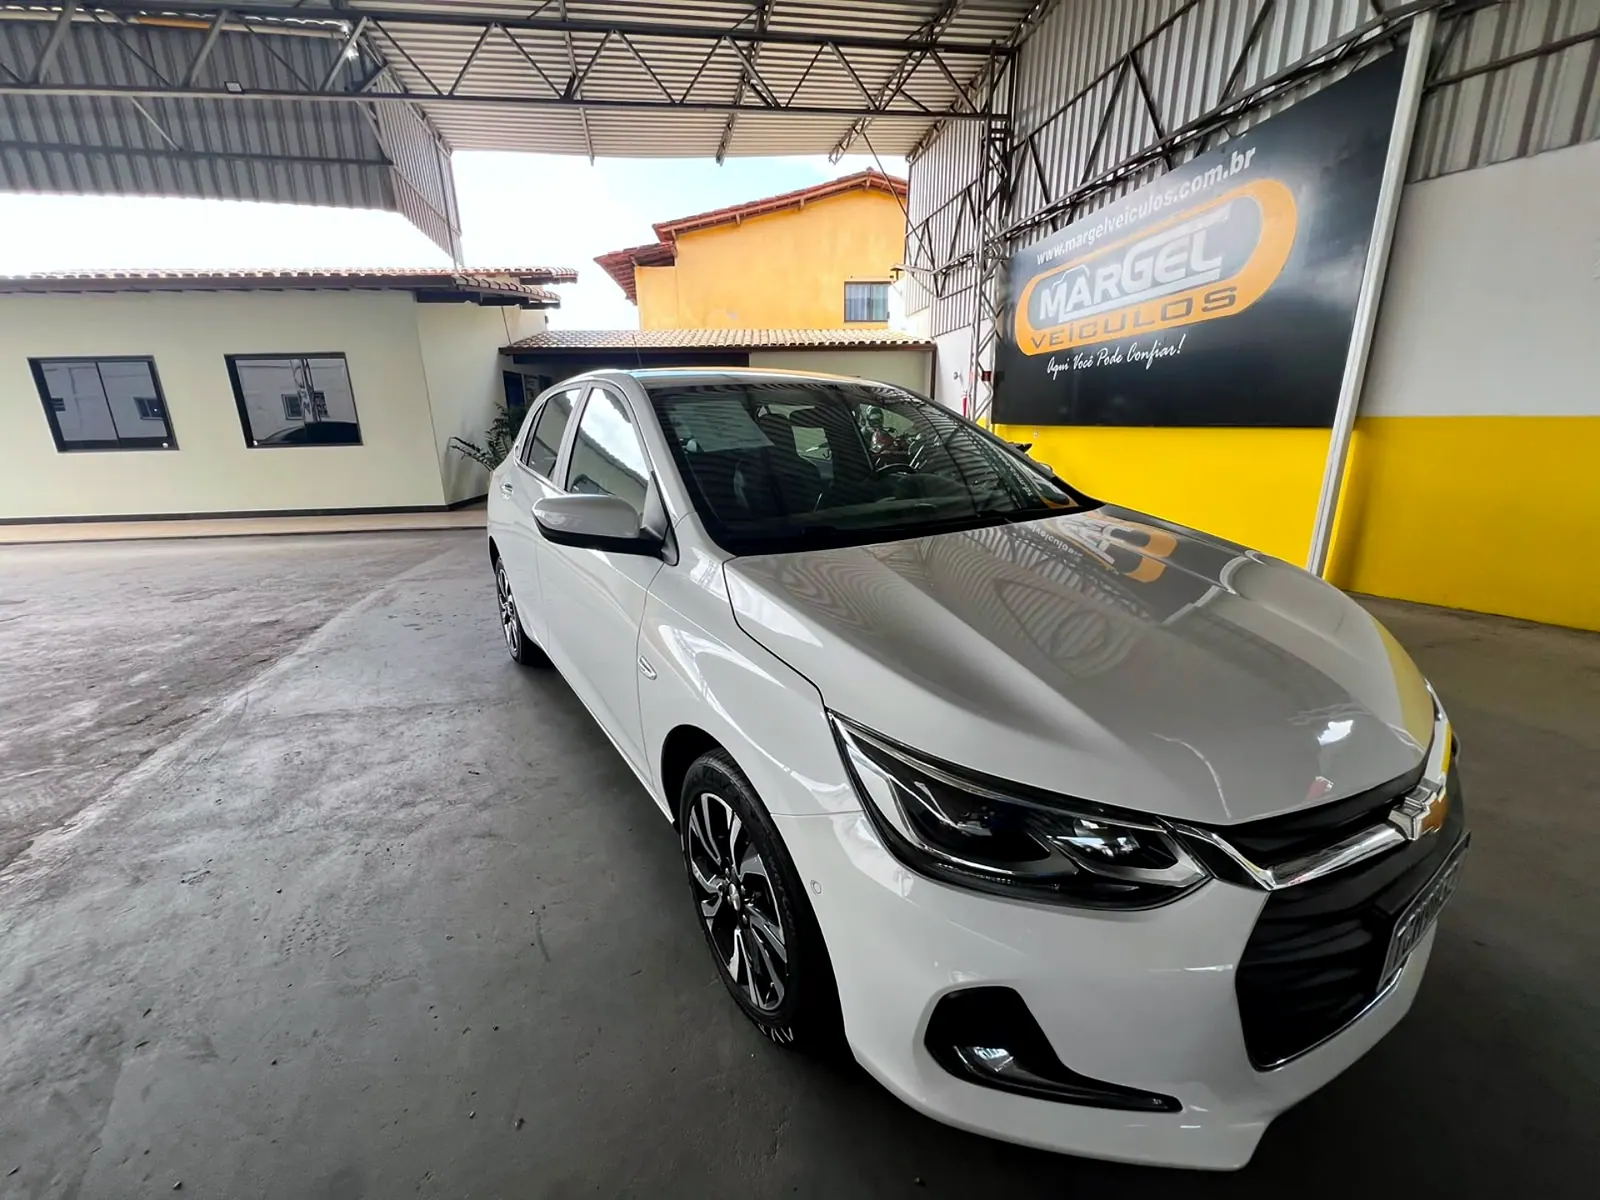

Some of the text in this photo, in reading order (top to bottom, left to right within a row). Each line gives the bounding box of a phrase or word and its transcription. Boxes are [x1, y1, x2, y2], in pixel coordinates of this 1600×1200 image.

[1036, 148, 1257, 265] www.margelveiculos.com.br
[1047, 333, 1186, 380] Aqui Você Pode Confiar!
